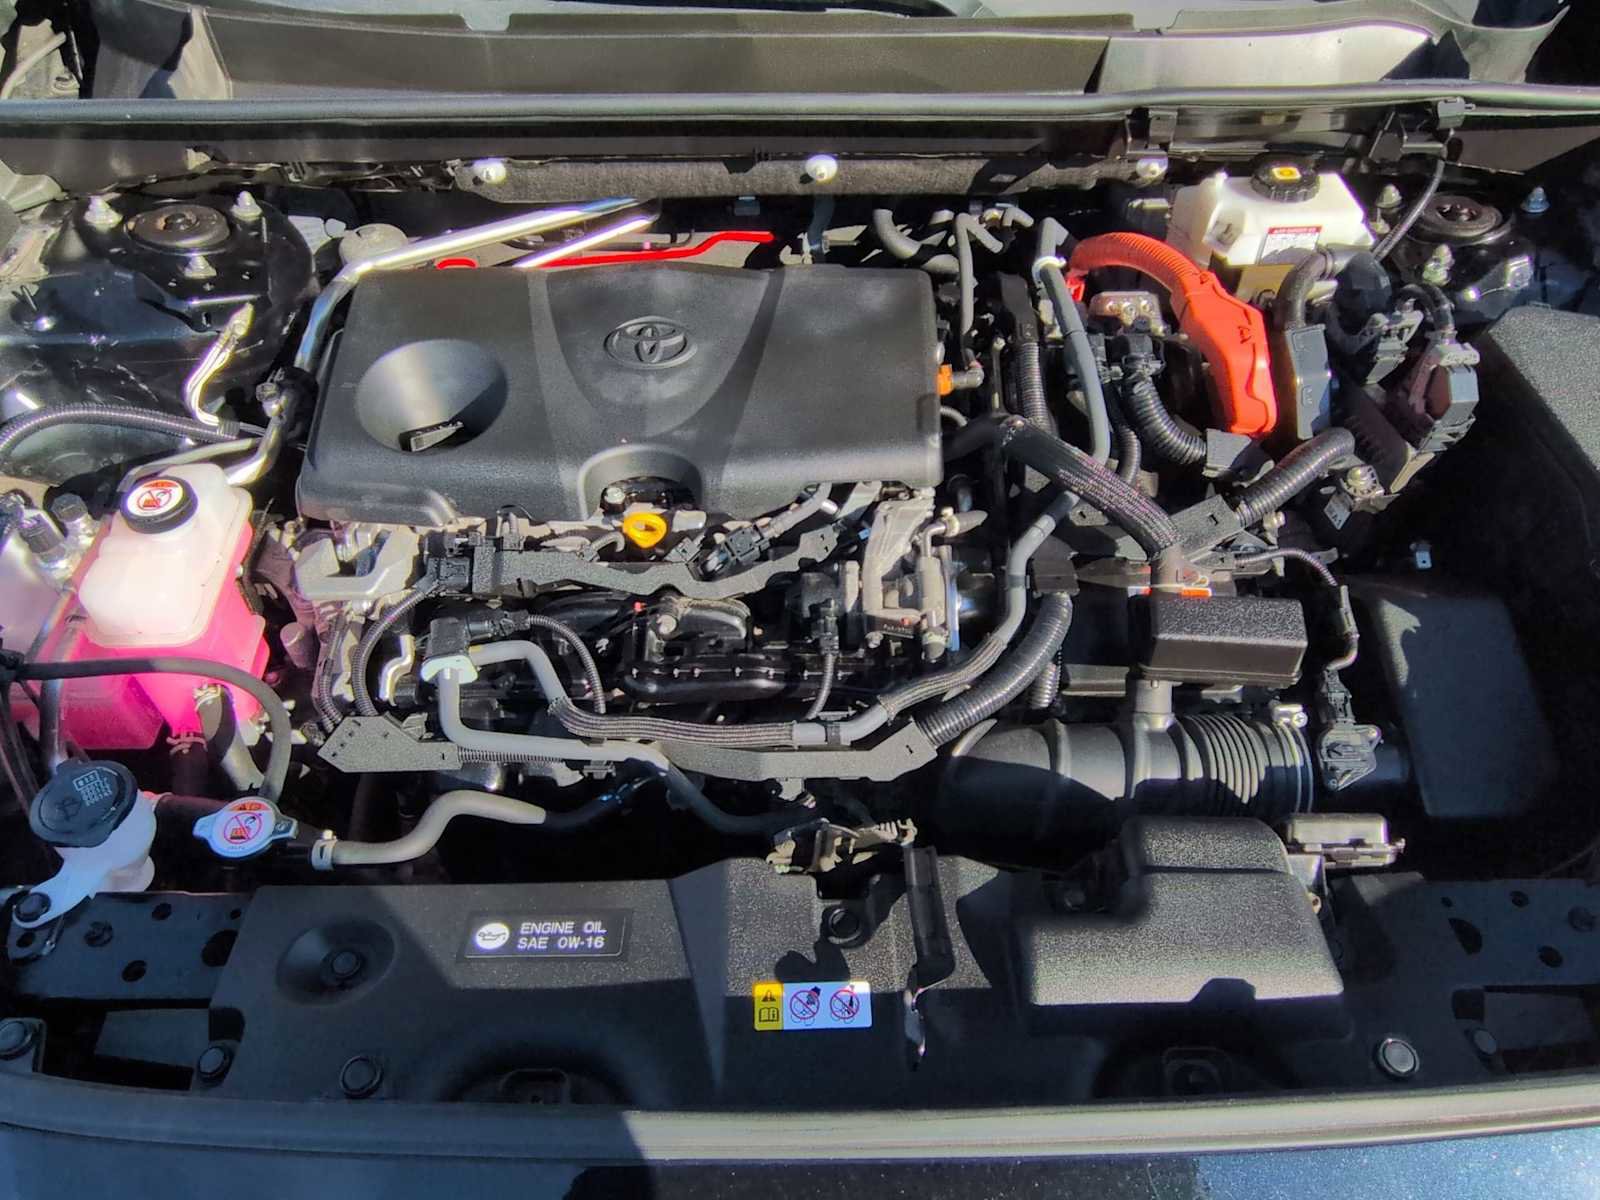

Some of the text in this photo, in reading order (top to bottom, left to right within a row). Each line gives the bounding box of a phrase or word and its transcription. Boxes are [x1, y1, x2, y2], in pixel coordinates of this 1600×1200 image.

[520, 921, 607, 935] ENGINE OIL
[517, 936, 605, 949] SAE 0W-16
